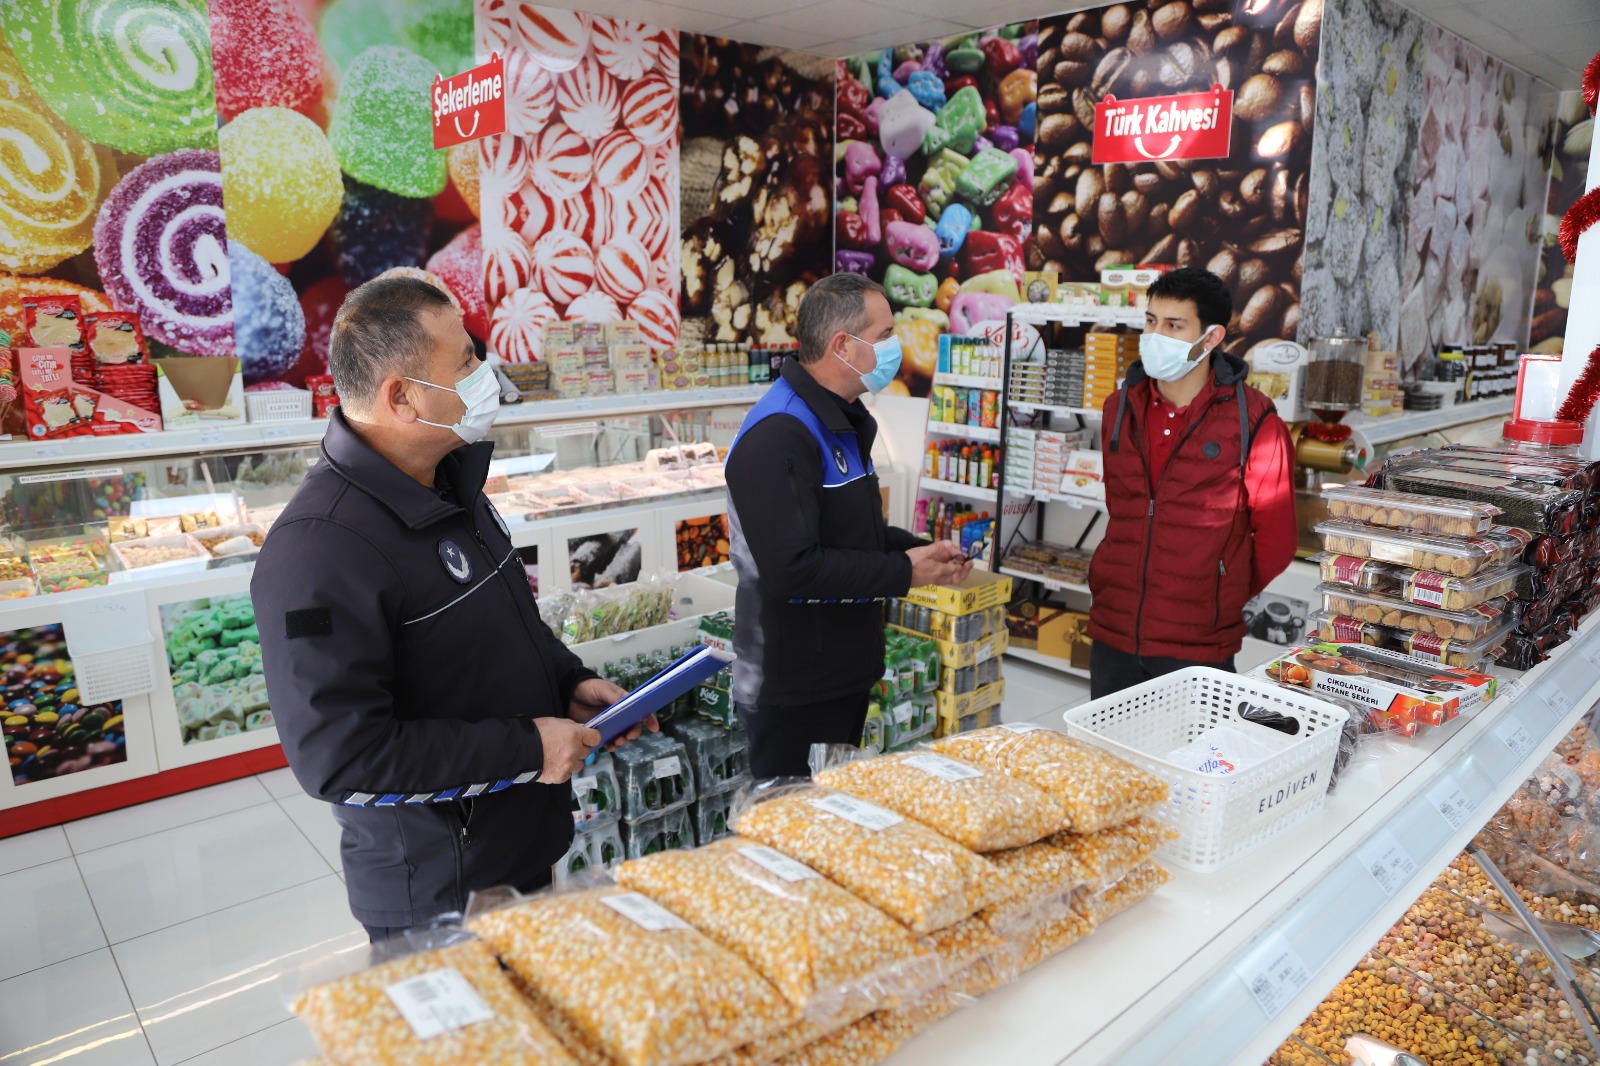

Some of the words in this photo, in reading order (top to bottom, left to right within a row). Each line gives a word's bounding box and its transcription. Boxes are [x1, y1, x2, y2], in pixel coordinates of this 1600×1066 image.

[434, 73, 502, 127] Şekerleme
[1105, 104, 1144, 137] Türk
[1145, 97, 1220, 135] Kahvesi
[699, 687, 720, 701] Kula
[1317, 682, 1350, 697] KESTANE
[1258, 769, 1318, 814] ELDİVEN
